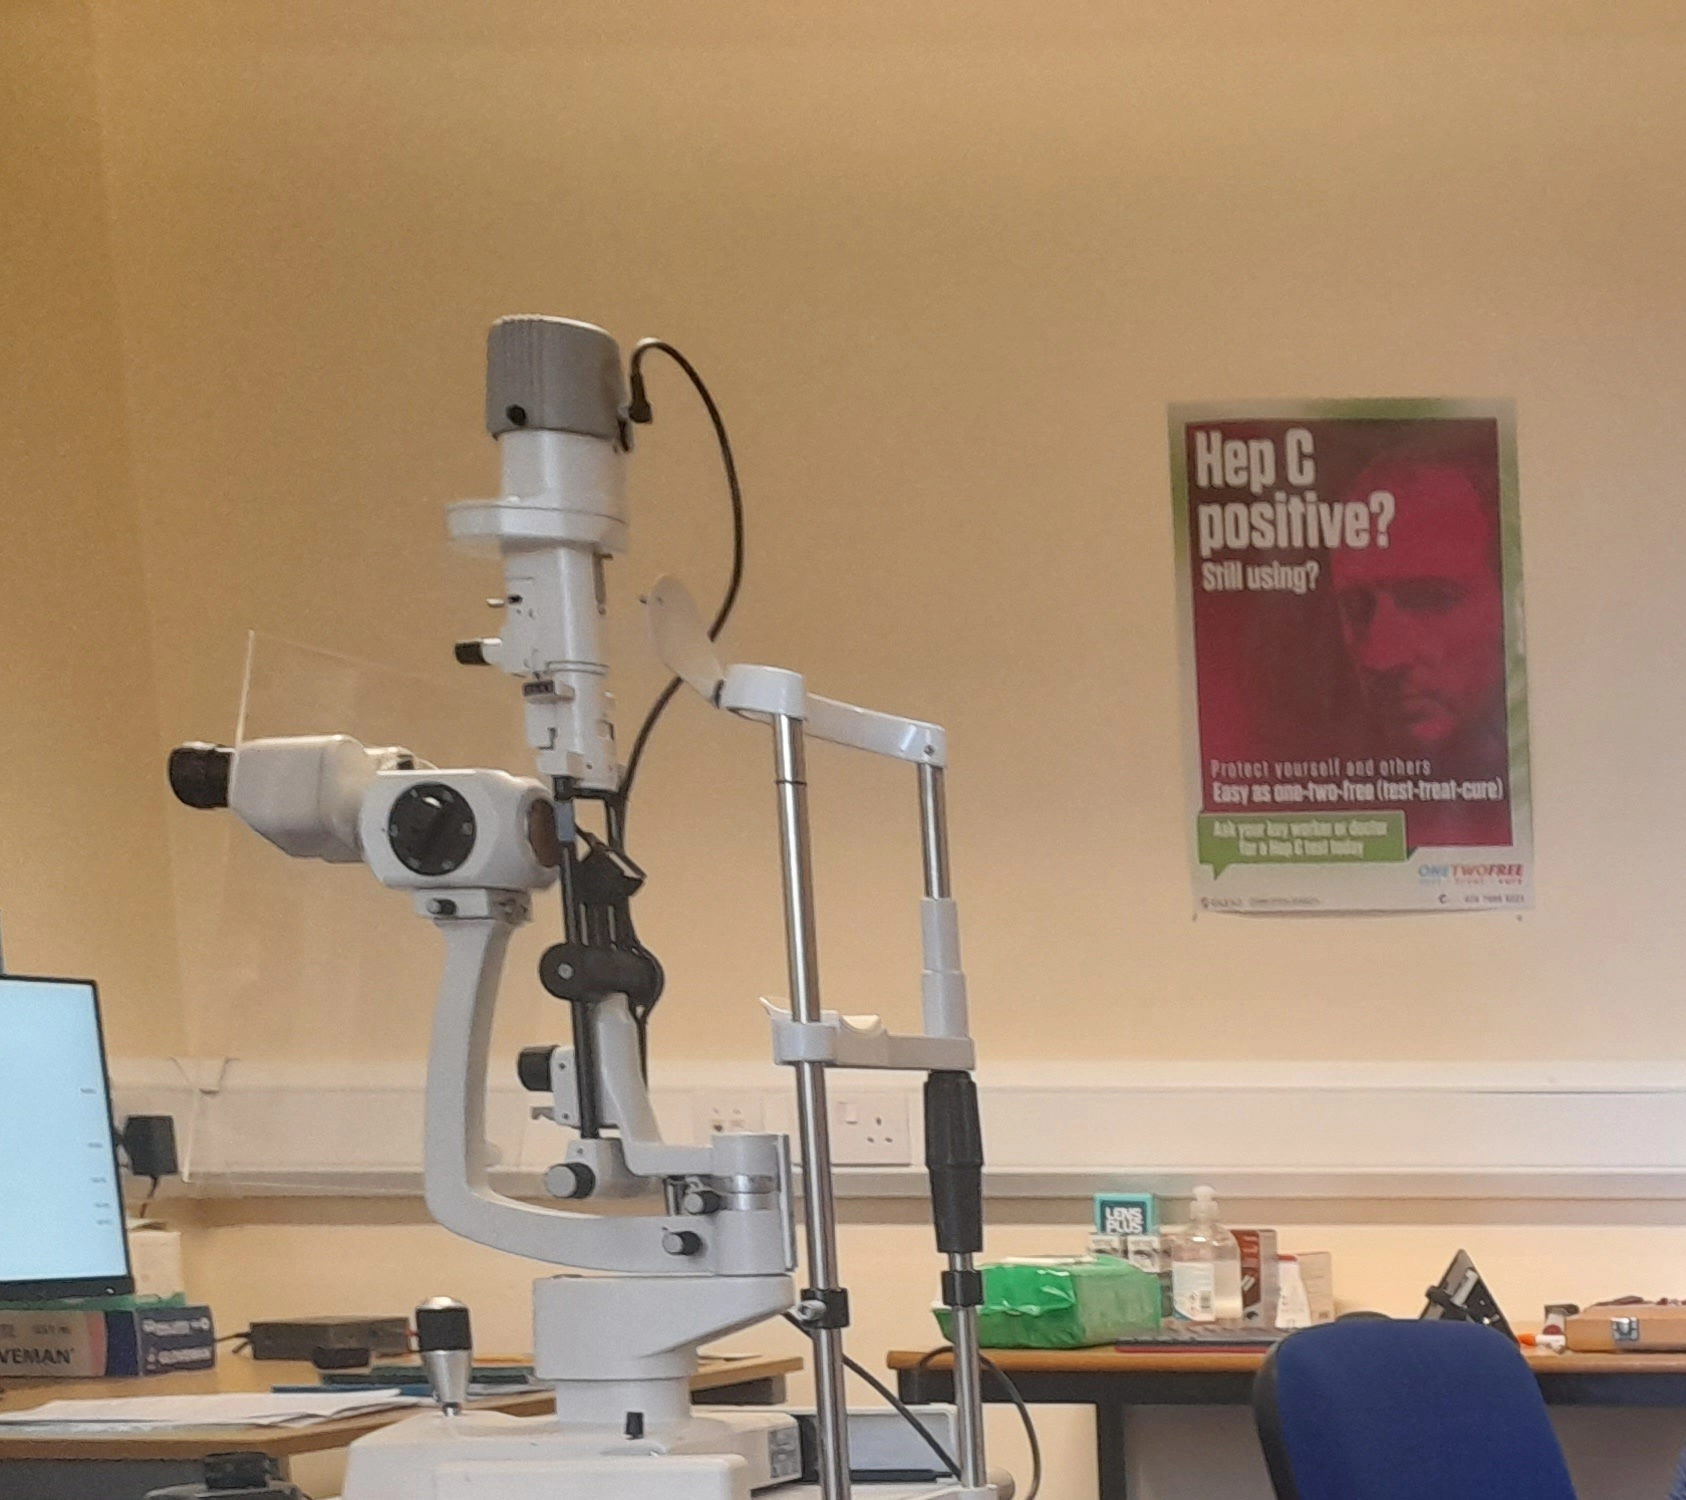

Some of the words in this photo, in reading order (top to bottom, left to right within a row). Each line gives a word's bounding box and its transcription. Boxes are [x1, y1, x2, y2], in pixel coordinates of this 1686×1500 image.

[1195, 429, 1276, 495] Hep
[1285, 427, 1316, 487] C
[1198, 490, 1396, 559] positive?
[1201, 560, 1244, 592] Still
[1246, 559, 1320, 595] using?
[1210, 759, 1269, 778] Protect
[1275, 757, 1341, 780] yourself
[1346, 759, 1374, 777] and
[1379, 757, 1431, 777] others
[1212, 781, 1249, 806] Easy
[1251, 783, 1272, 803] as
[1272, 779, 1375, 803] one-two-free
[1377, 776, 1504, 801] (test-treat-cure)
[1105, 1207, 1143, 1220] LENS
[1106, 1220, 1143, 1234] PLUS
